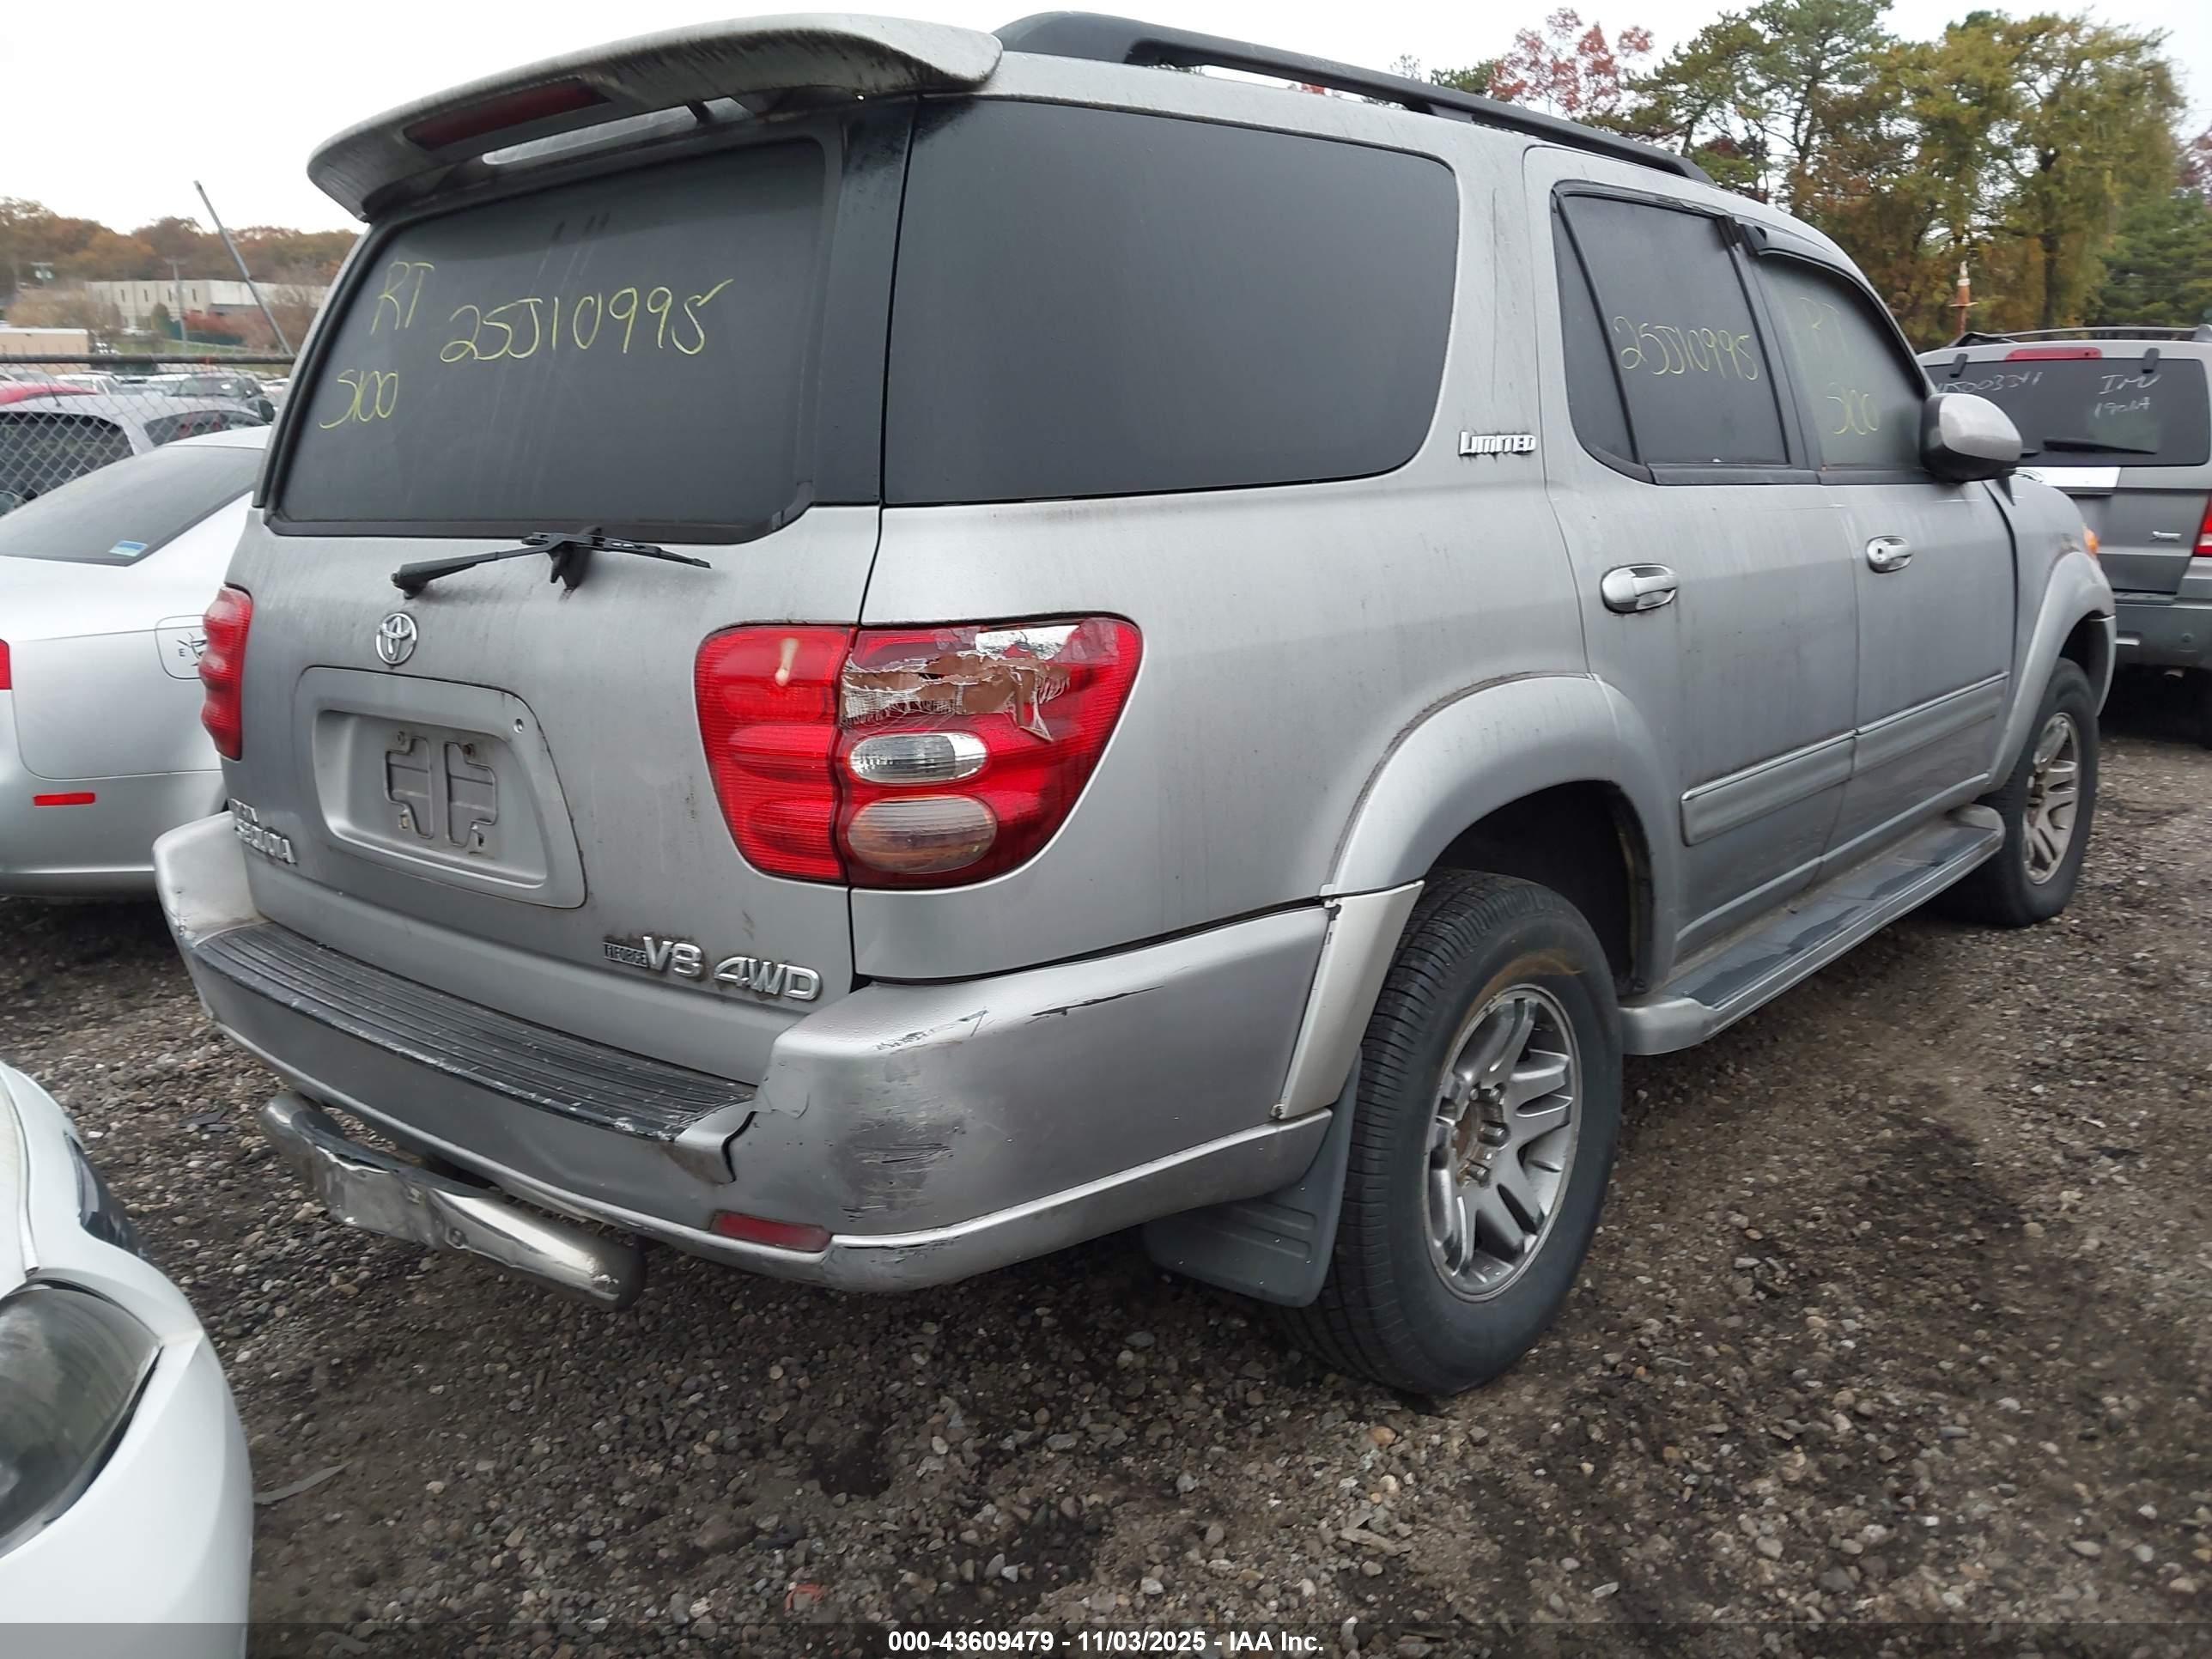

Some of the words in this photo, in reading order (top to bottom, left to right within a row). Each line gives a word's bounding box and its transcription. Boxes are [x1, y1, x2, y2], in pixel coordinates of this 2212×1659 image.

[371, 262, 435, 334] RT
[643, 935, 704, 978] V8
[714, 956, 820, 1001] 4WD
